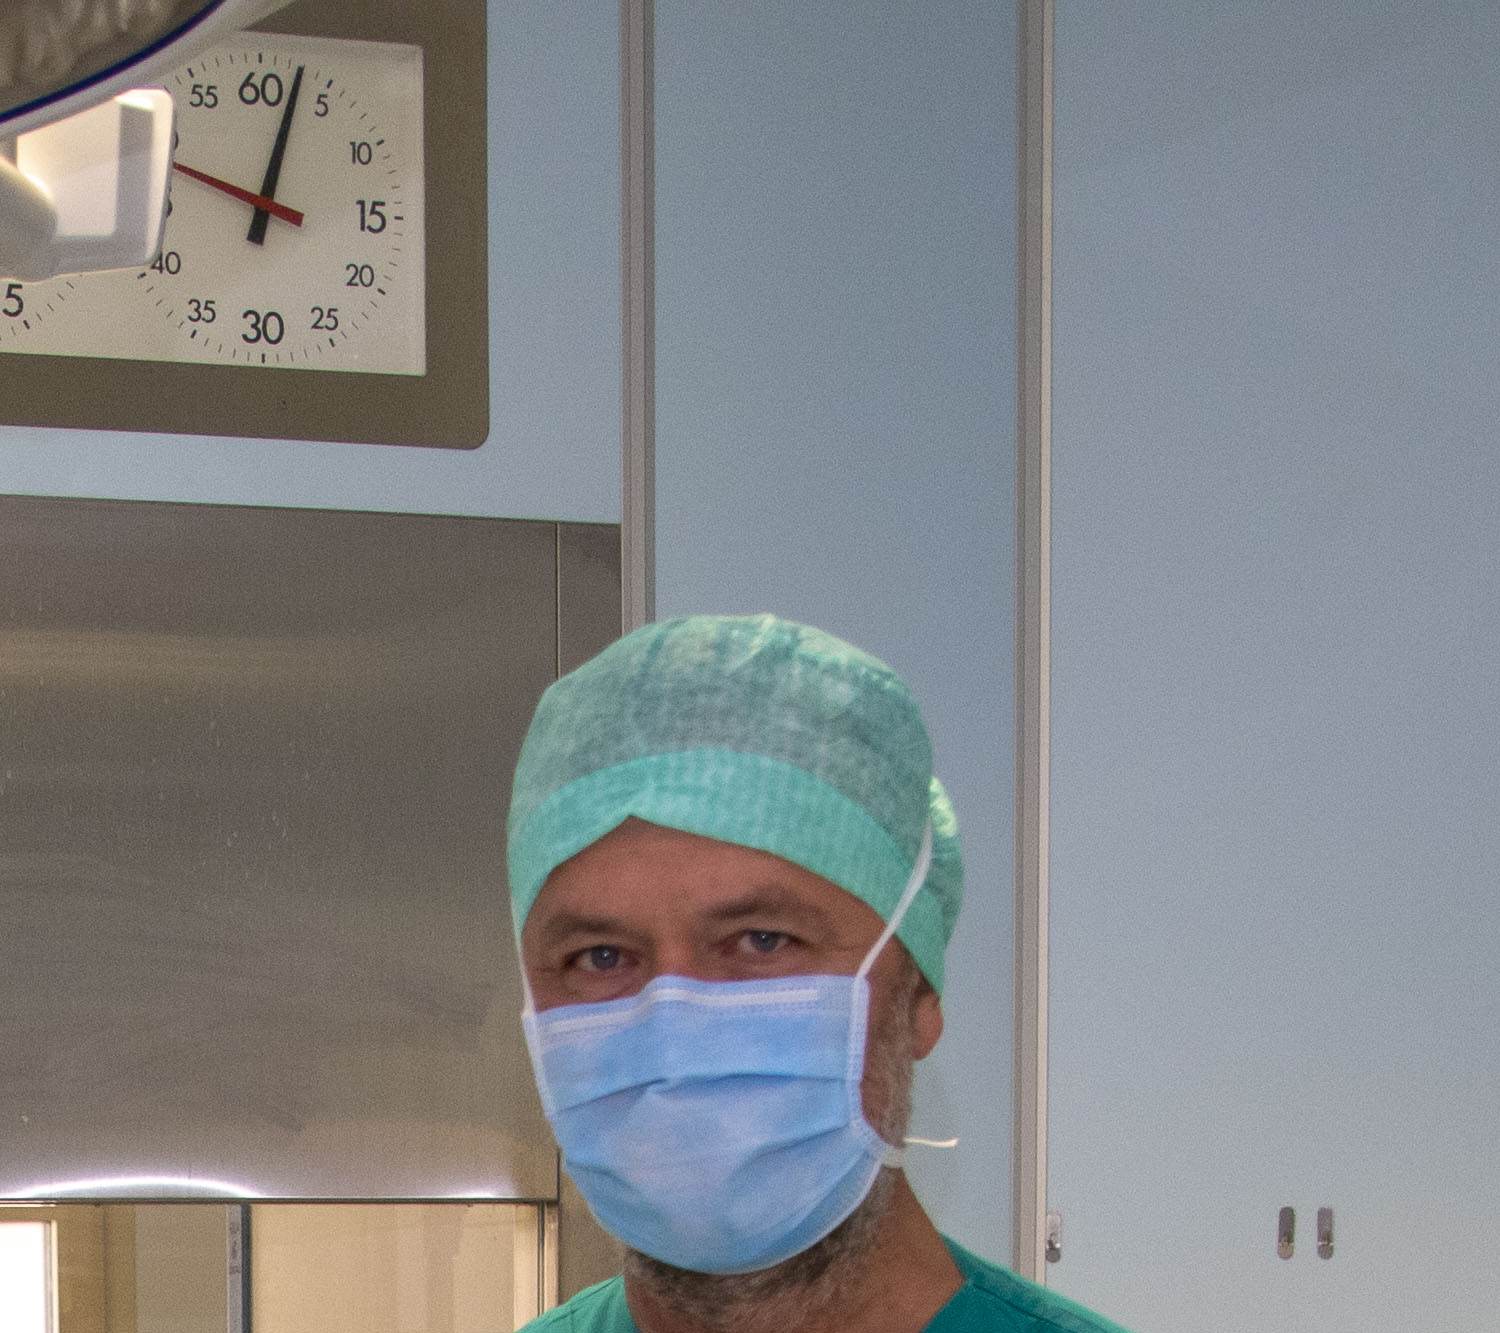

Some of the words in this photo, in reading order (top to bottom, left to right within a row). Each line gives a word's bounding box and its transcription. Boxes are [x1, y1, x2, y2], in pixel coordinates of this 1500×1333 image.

[190, 84, 218, 108] 55
[238, 72, 283, 107] 60
[315, 94, 329, 117] 5
[350, 142, 372, 165] 10
[356, 200, 387, 233] 15
[150, 251, 181, 275] 40
[345, 264, 375, 287] 20
[2, 283, 24, 317] 5
[187, 299, 216, 323] 35
[241, 309, 285, 344] 30
[310, 306, 339, 331] 25
